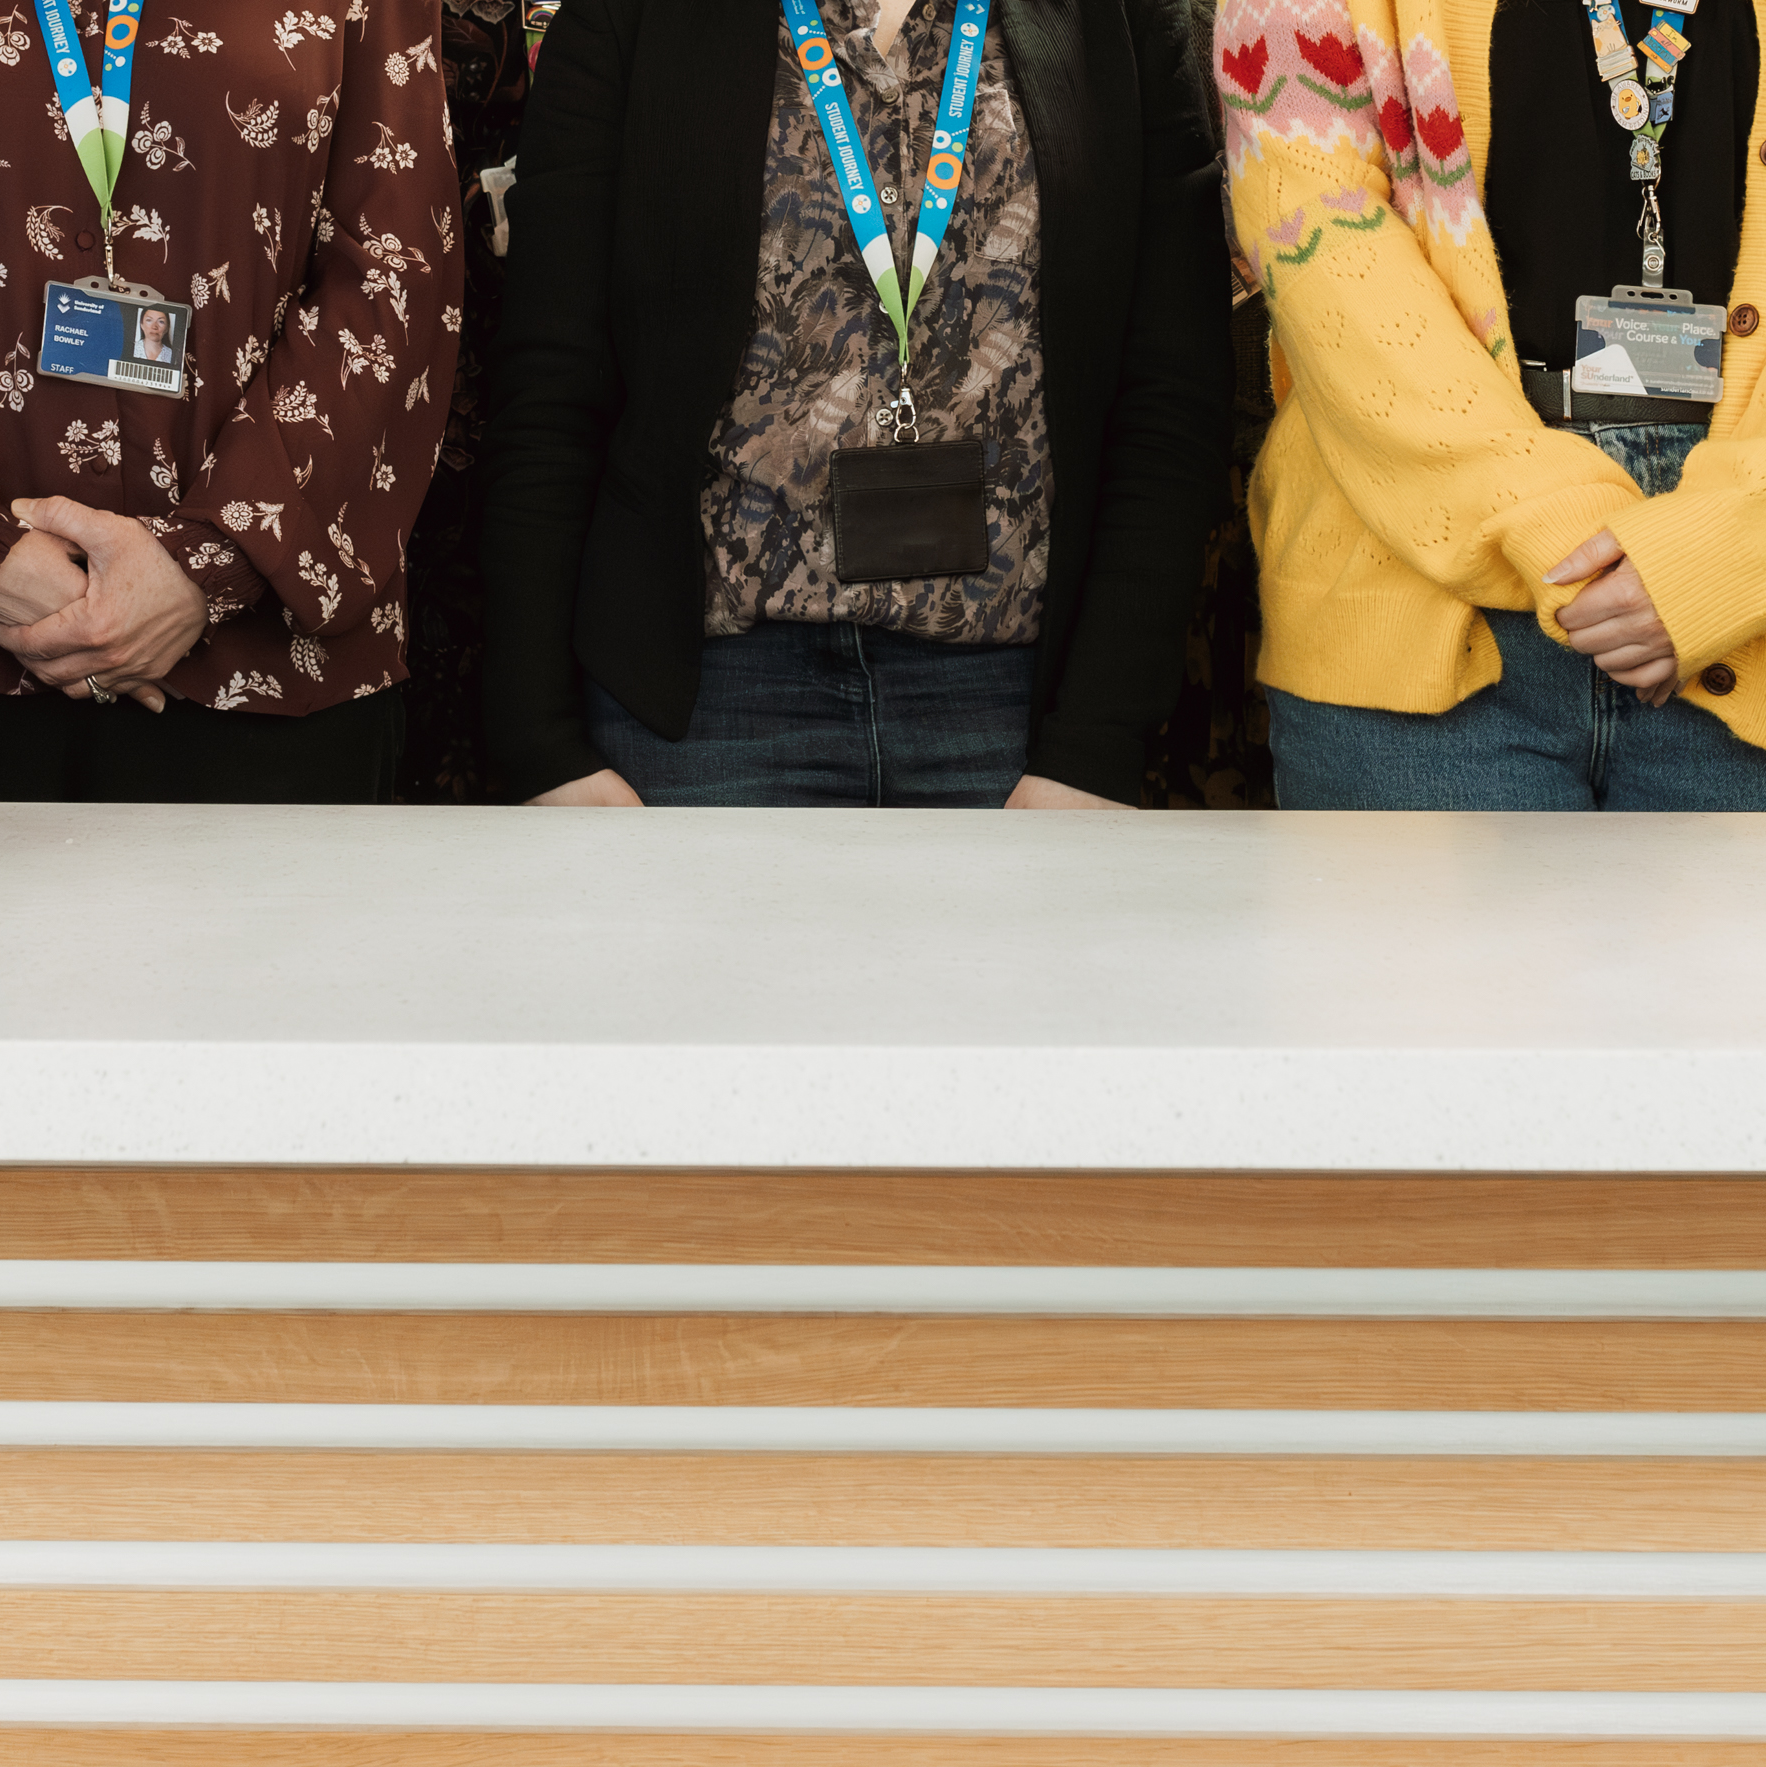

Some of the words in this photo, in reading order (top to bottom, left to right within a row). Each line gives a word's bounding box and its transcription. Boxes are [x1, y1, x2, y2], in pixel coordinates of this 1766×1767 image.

[45, 8, 71, 53] JOURNEY
[948, 76, 968, 118] STUDENT
[958, 38, 975, 79] JOURNEY
[824, 101, 850, 144] STUDENT
[837, 144, 864, 190] JOURNEY
[54, 324, 89, 337] RACHAEL
[1615, 317, 1650, 331] Voice.
[1682, 322, 1717, 336] Place.
[54, 334, 85, 347] BOWLEY
[1626, 330, 1669, 344] Course
[1670, 336, 1678, 345] &
[1679, 334, 1704, 347] You.
[50, 363, 75, 374] STAFF
